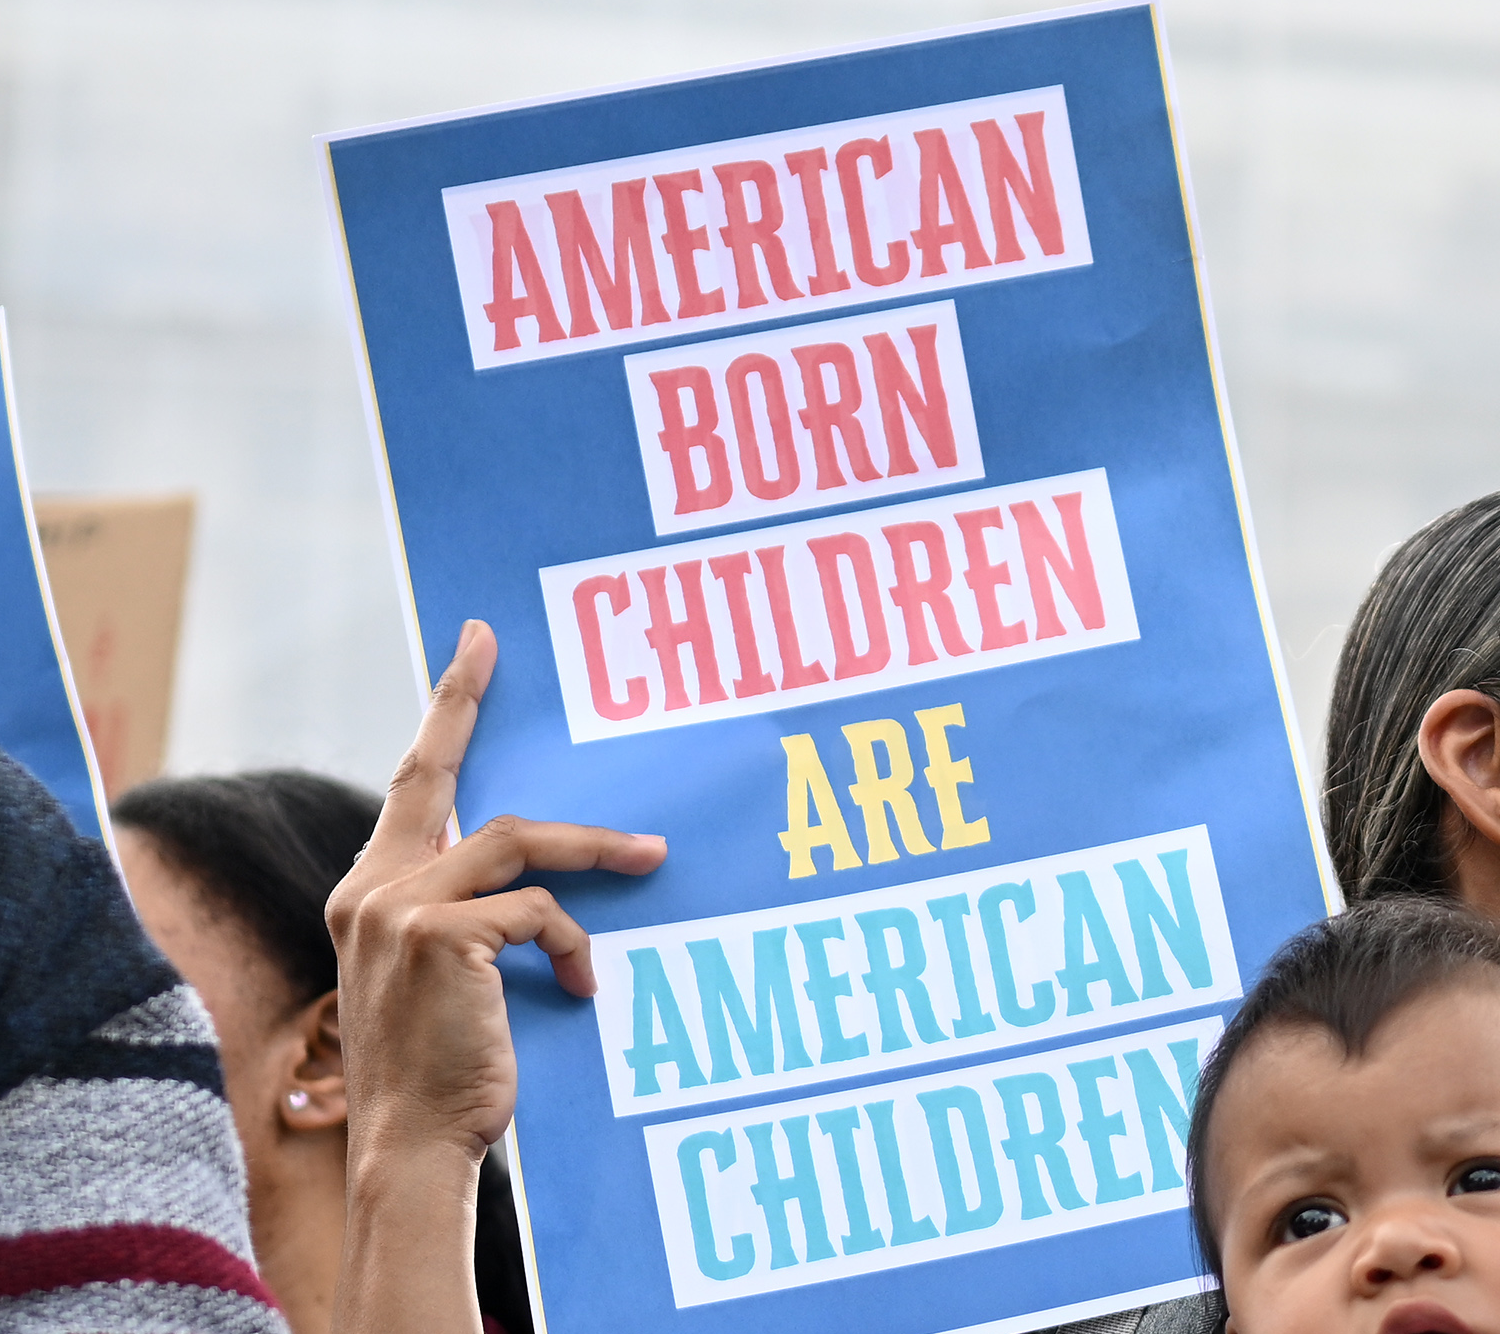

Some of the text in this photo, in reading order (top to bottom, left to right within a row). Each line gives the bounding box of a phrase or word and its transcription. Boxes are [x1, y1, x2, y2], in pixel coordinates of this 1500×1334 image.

[484, 111, 1065, 352] AMERICAN
[649, 324, 958, 516] BORN
[573, 492, 1106, 721] CHILDREN
[779, 703, 990, 878] ARE
[623, 848, 1214, 1098] AMERICAN
[677, 1037, 1198, 1282] CHILDREN
